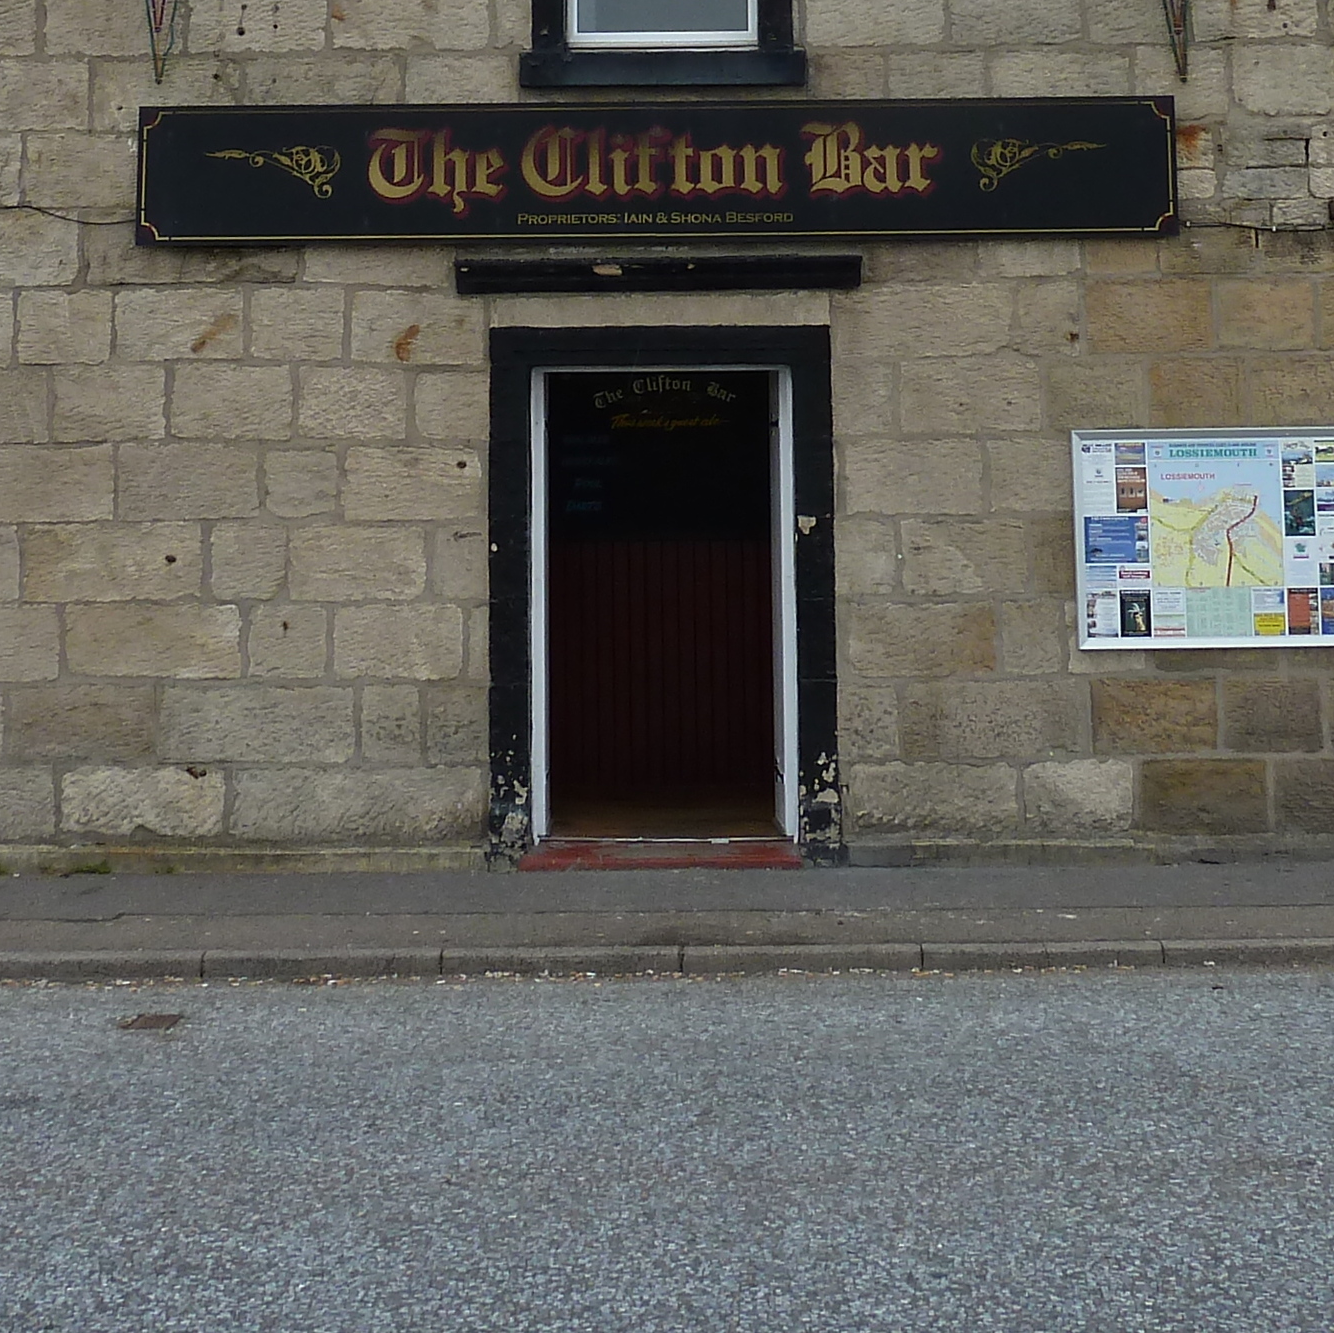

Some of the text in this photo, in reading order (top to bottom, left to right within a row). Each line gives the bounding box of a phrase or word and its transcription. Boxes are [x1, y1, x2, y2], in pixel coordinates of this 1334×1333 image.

[368, 122, 939, 213] The Clifton Bar
[656, 212, 668, 224] &
[593, 374, 737, 409] The Clifton Bar
[1169, 448, 1257, 458] LOSSIEMOUTH
[1161, 473, 1215, 481] LOSSIEMOUTH
